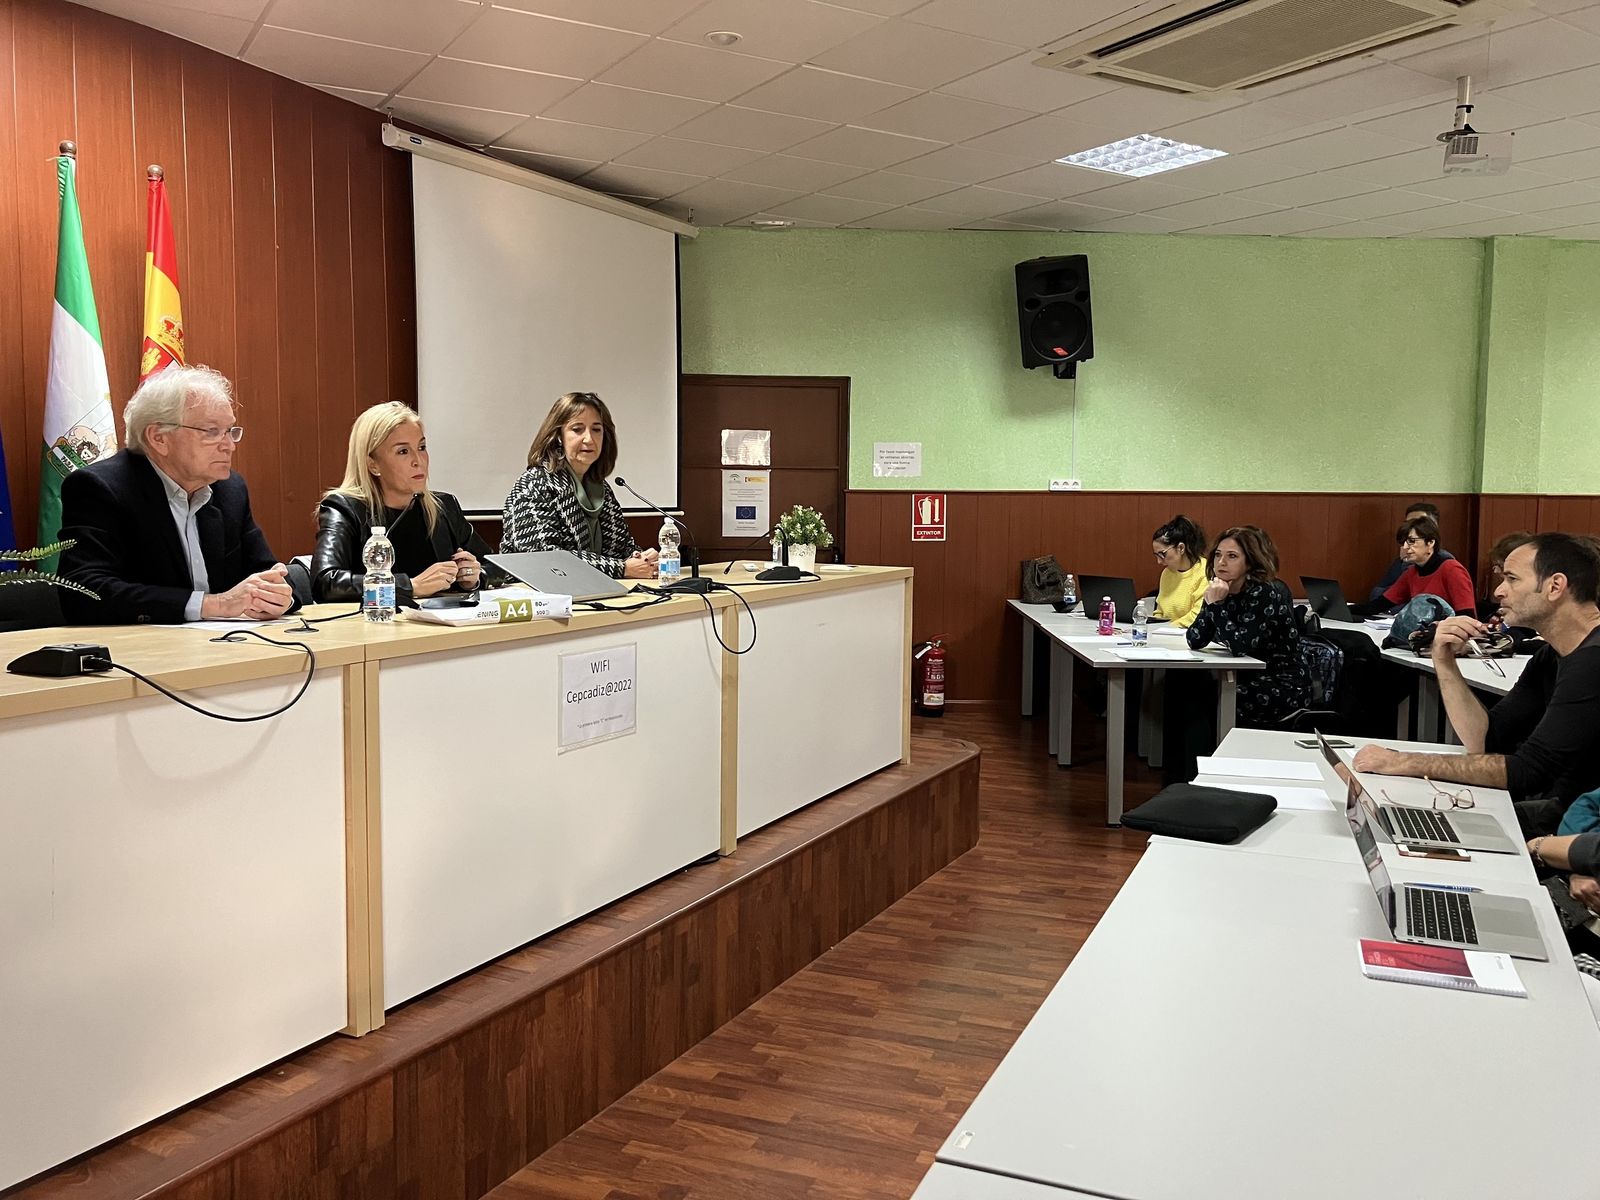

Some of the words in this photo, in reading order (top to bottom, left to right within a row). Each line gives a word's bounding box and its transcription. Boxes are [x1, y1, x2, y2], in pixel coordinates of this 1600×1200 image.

[505, 602, 528, 618] A4
[590, 659, 610, 674] WIFI
[566, 678, 632, 704] Cepcadiz@2022
